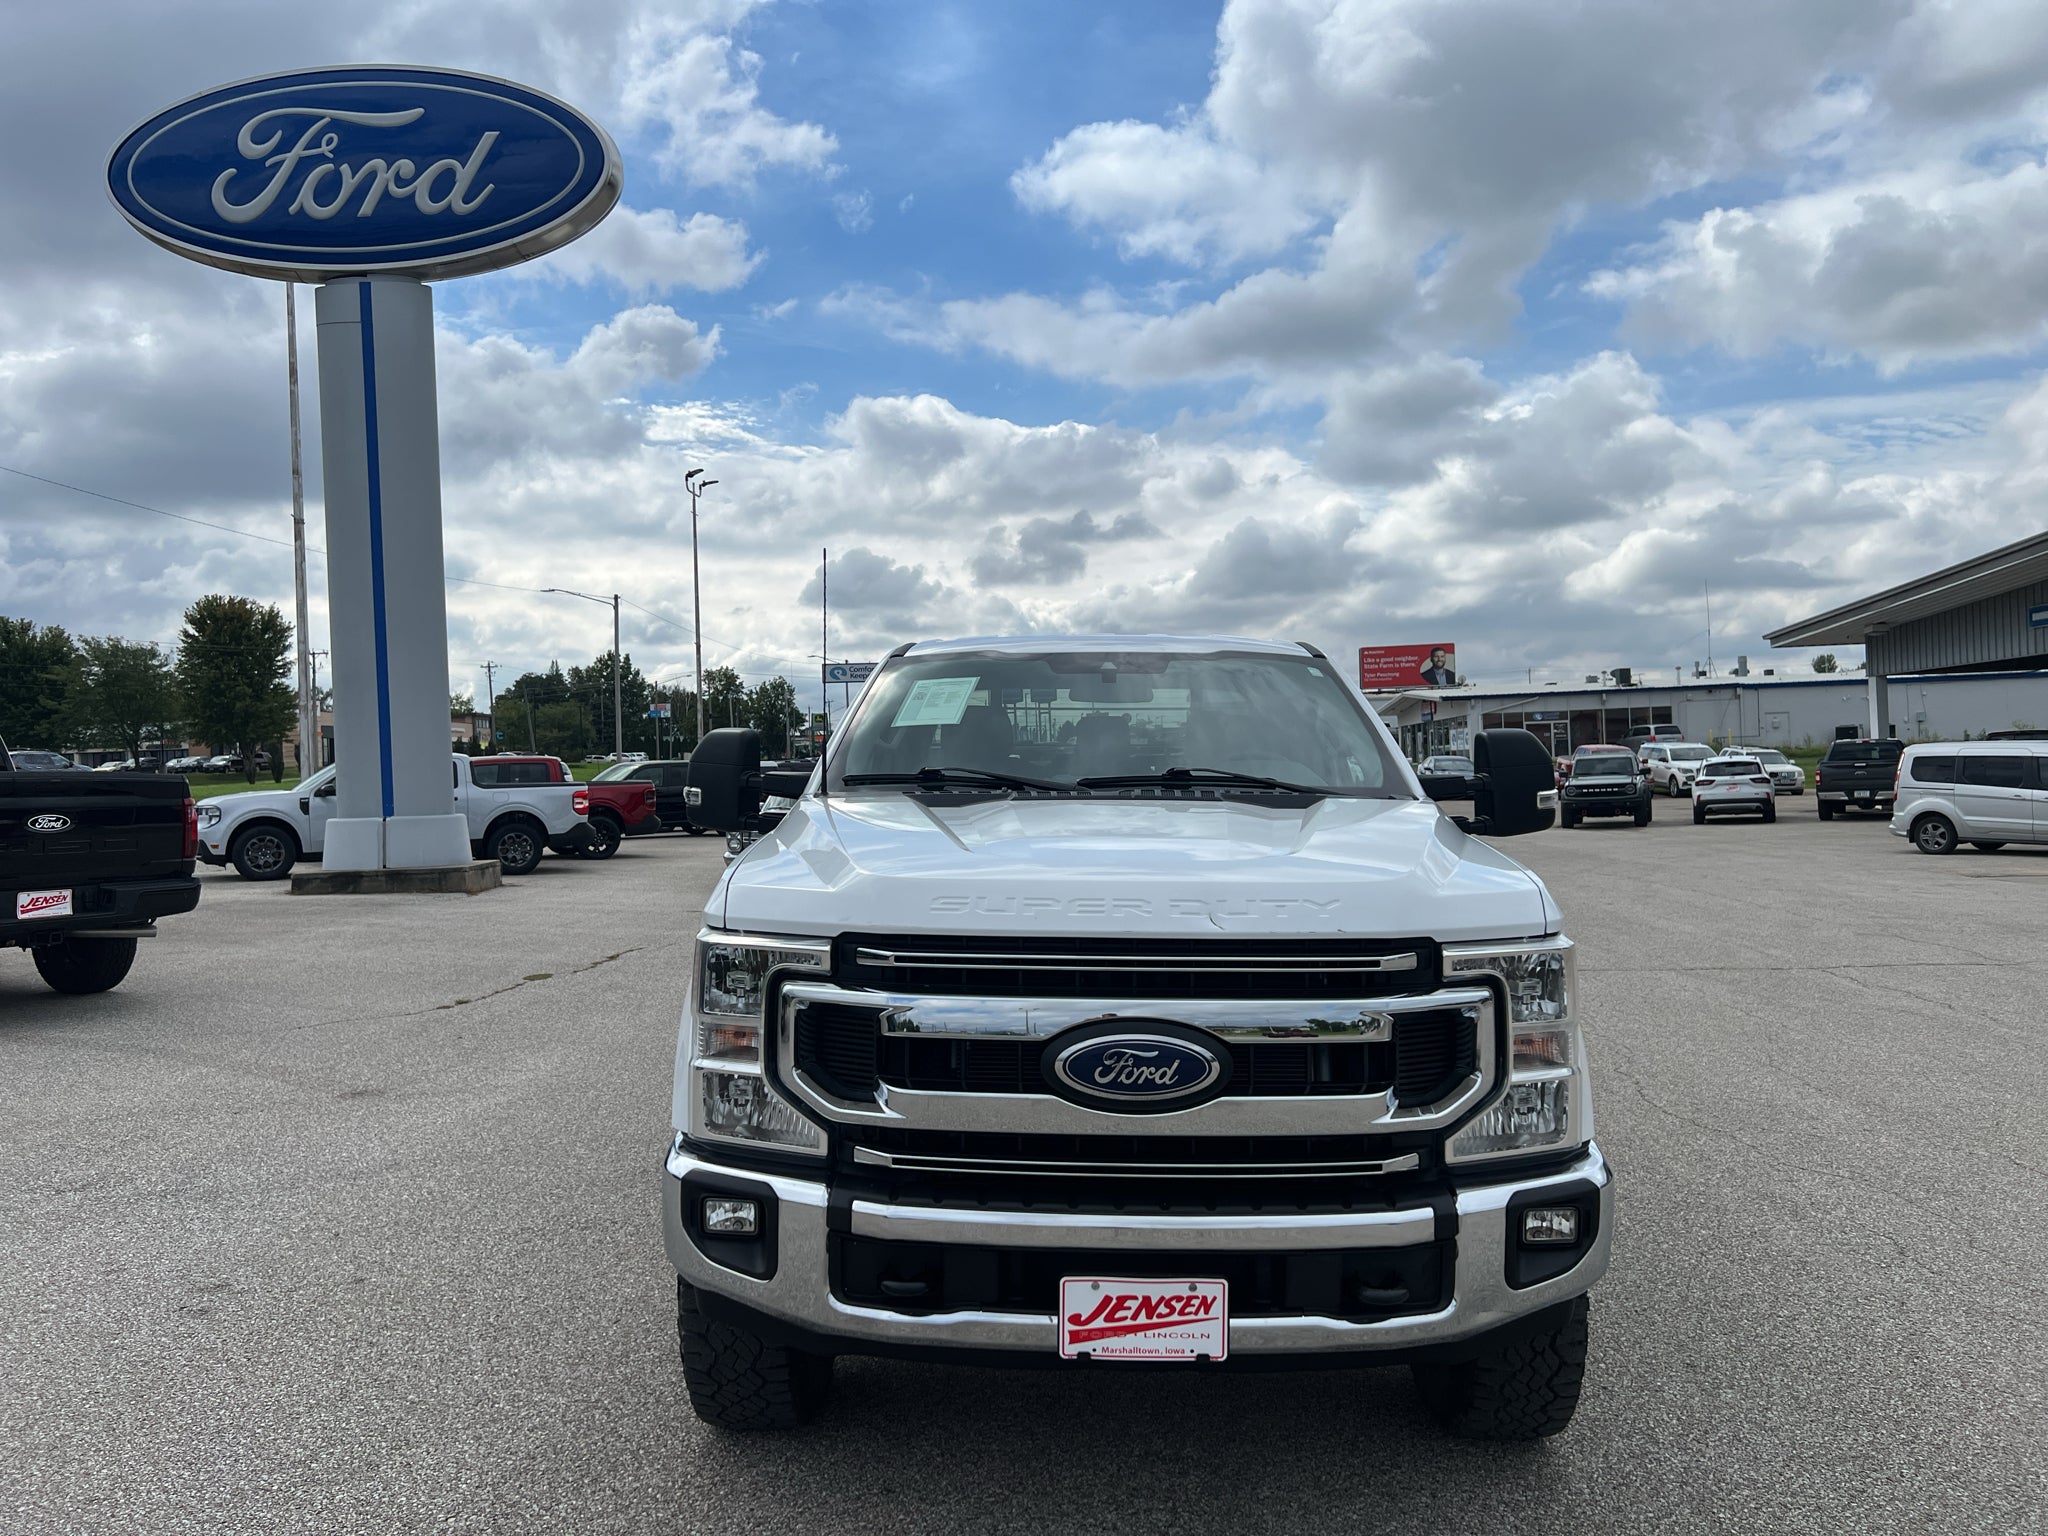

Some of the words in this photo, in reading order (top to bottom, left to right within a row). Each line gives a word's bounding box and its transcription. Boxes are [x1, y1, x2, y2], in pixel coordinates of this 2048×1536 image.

[210, 106, 500, 224] Ford
[1380, 656, 1394, 664] good
[35, 816, 63, 829] Ford
[20, 895, 69, 909] JENSEN
[929, 895, 1153, 918] SUPER
[1168, 898, 1342, 918] DUTY
[1094, 1048, 1181, 1085] Ford
[1067, 1294, 1218, 1327] JENSEN
[1144, 1332, 1211, 1340] LINCOLN
[1101, 1346, 1164, 1355] Marshalltown,
[1165, 1347, 1186, 1355] Iowa
